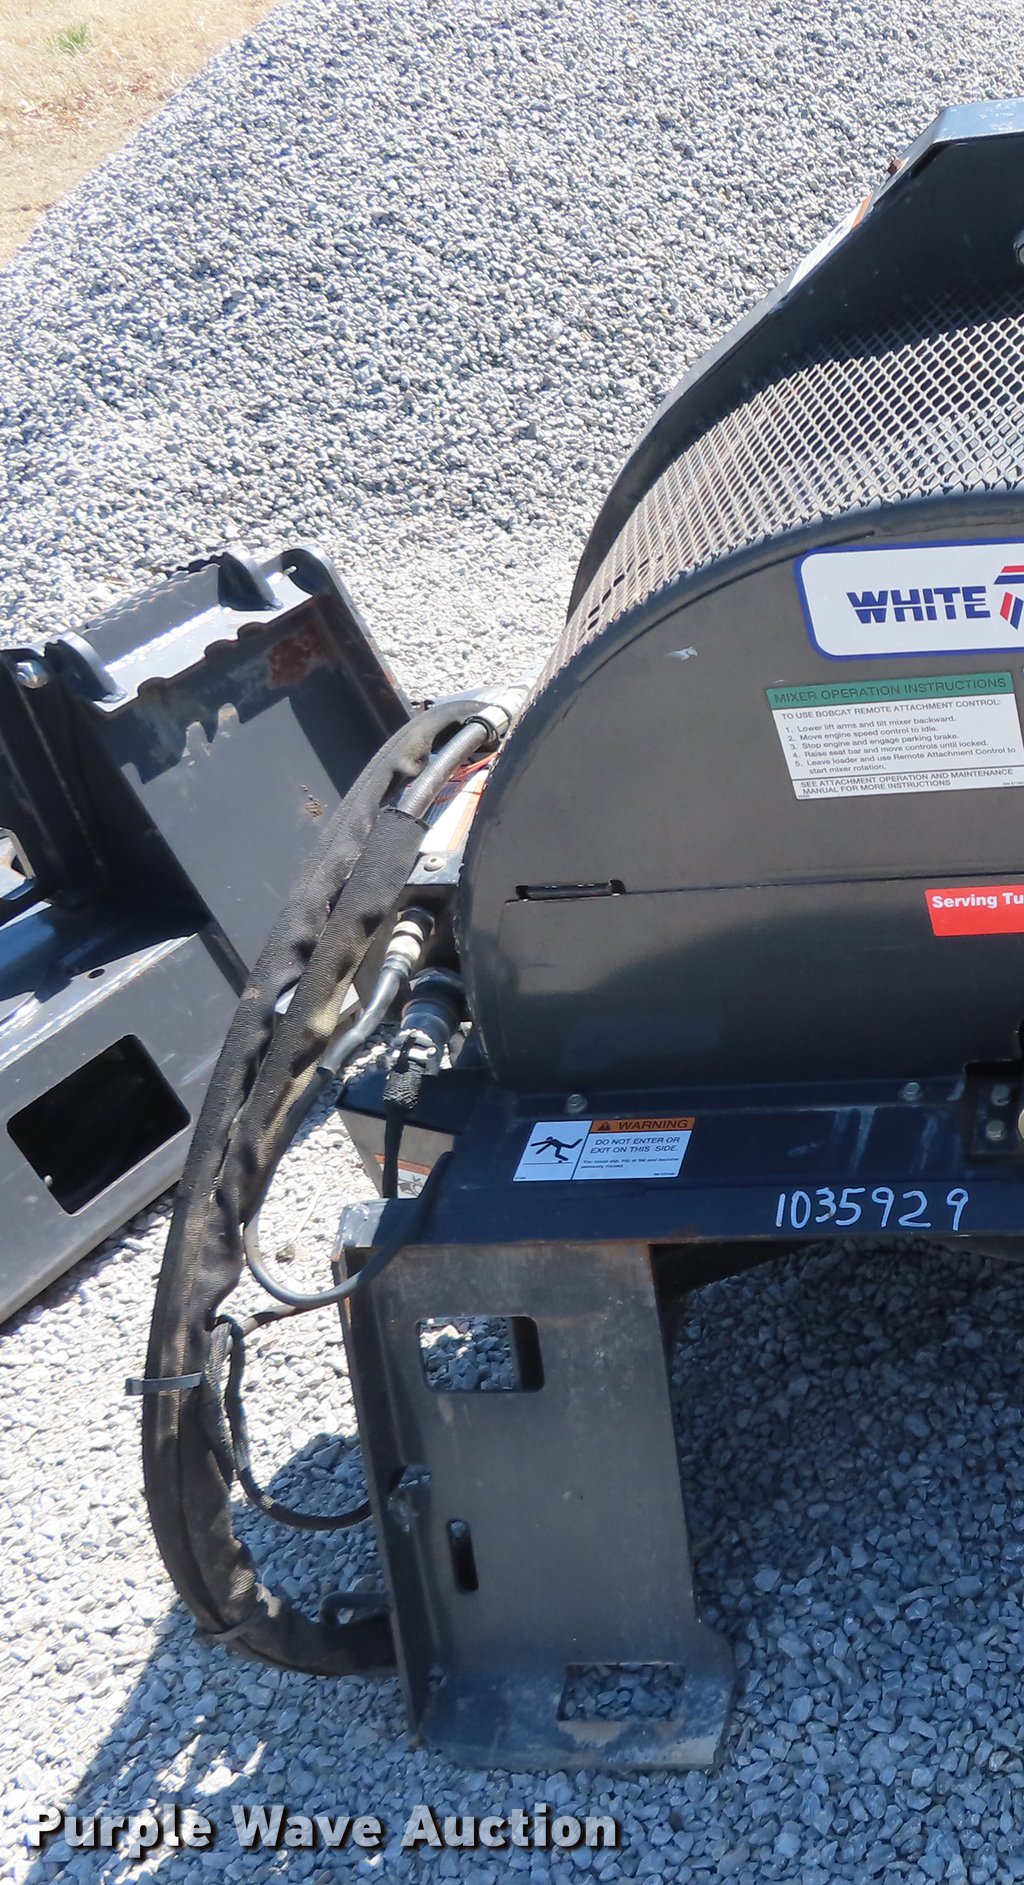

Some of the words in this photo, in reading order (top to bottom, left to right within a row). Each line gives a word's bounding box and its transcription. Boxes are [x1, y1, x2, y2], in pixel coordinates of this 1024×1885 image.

[847, 585, 992, 625] WHITE
[774, 690, 818, 703] MIXER
[821, 684, 900, 700] OPERATION
[904, 677, 1007, 694] INSTRUCTIONS
[796, 711, 814, 719] USE
[815, 709, 851, 717] BOBCAT
[854, 706, 892, 715] REMOTE
[893, 702, 953, 712] ATTACHMENT
[956, 699, 1001, 708] CONTROL:
[797, 724, 822, 732] Lower
[889, 718, 911, 726] mixer
[913, 715, 956, 724] backward.
[801, 742, 821, 750] Stop
[823, 740, 850, 748] engine
[869, 737, 899, 745] engage
[901, 735, 932, 743] parking
[824, 732, 851, 740] engine
[853, 730, 878, 738] speed
[905, 742, 938, 751] controls
[940, 741, 957, 749] until
[959, 739, 989, 747] locked.
[927, 750, 973, 758] Attachment
[975, 747, 1005, 755] Control
[853, 764, 887, 772] rotation.
[800, 780, 818, 788] SEE
[819, 776, 877, 787] ATTACHMENT
[878, 773, 928, 783] OPERATION
[930, 772, 949, 780] AND
[950, 769, 1013, 778] MAINTENANCE
[803, 787, 839, 795] MANUAL
[860, 783, 886, 791] MORE
[887, 779, 951, 789] INSTRUCTIONS
[932, 894, 997, 910] Serving
[618, 1119, 688, 1130] WARNING
